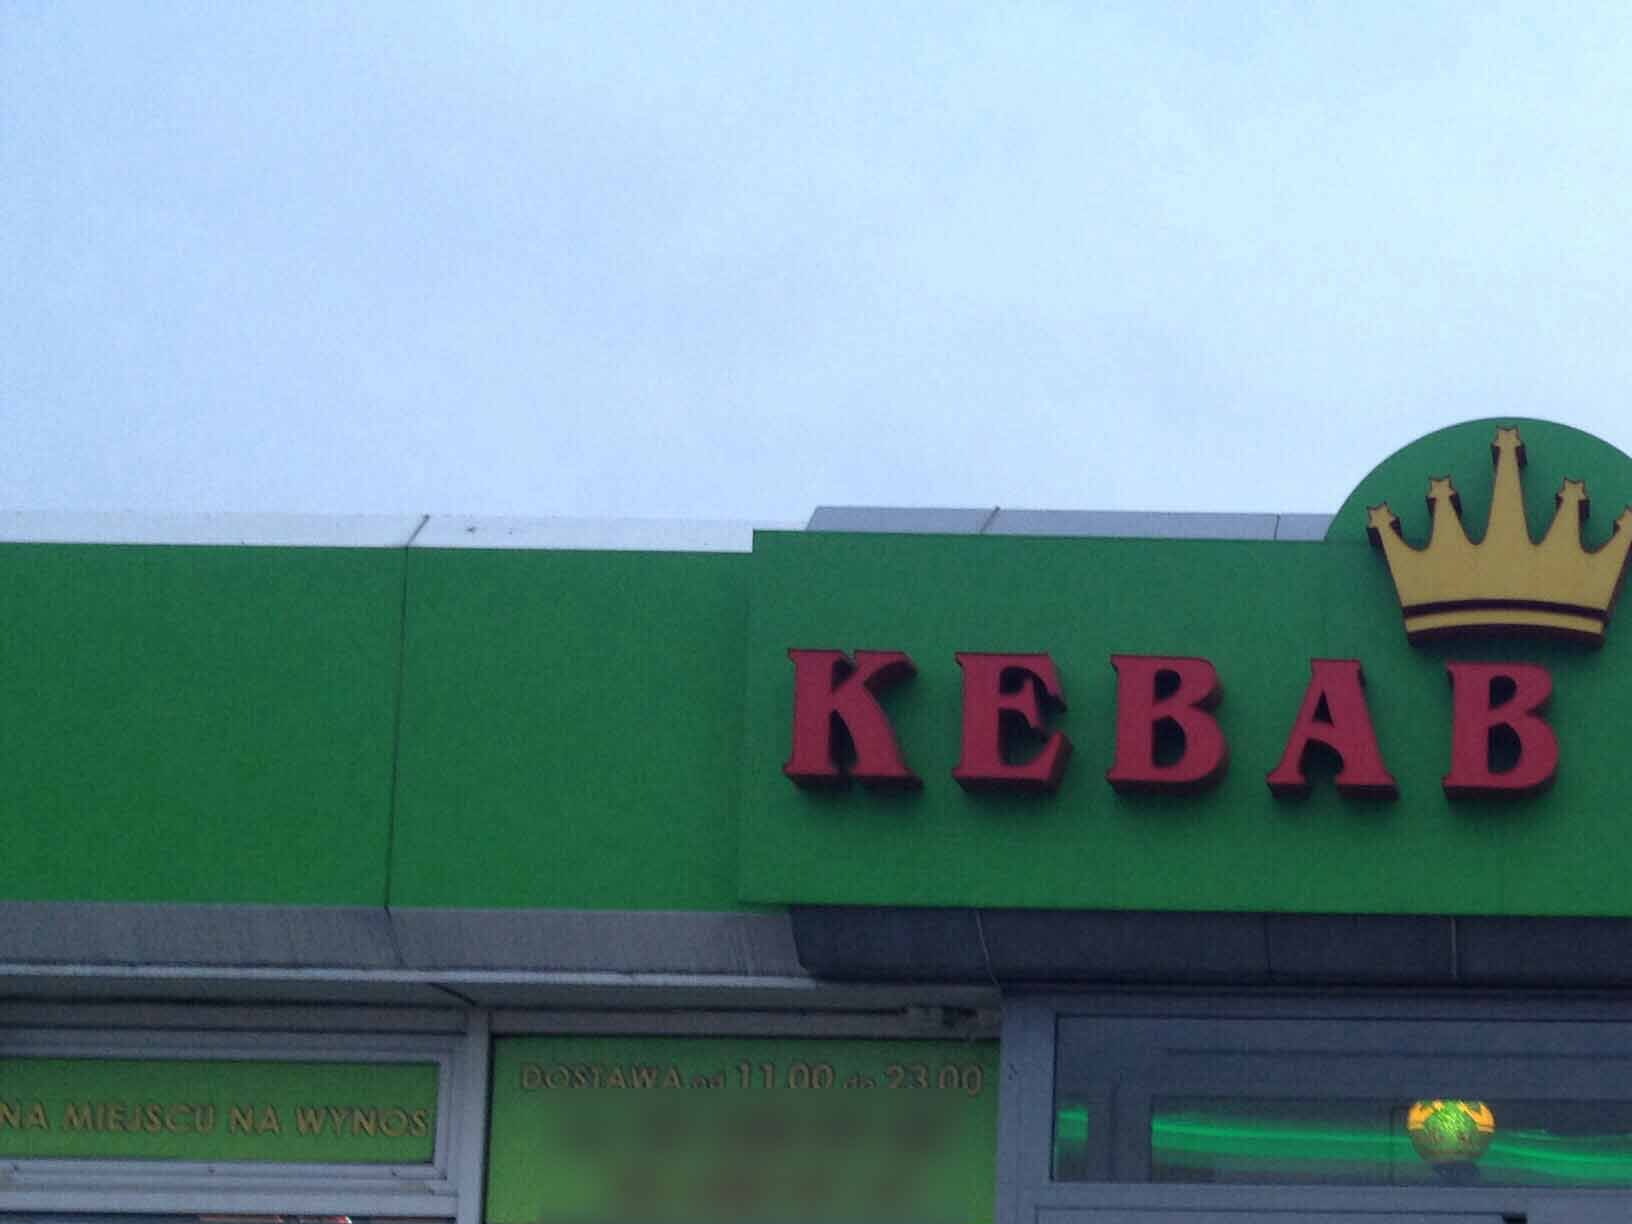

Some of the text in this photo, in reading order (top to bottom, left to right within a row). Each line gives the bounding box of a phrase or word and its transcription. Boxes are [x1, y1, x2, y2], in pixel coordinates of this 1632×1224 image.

[785, 648, 1560, 796] KEBAB
[521, 1063, 684, 1090] DOSTAWA
[0, 1103, 430, 1137] NA MIEJSCU NA WYNOS
